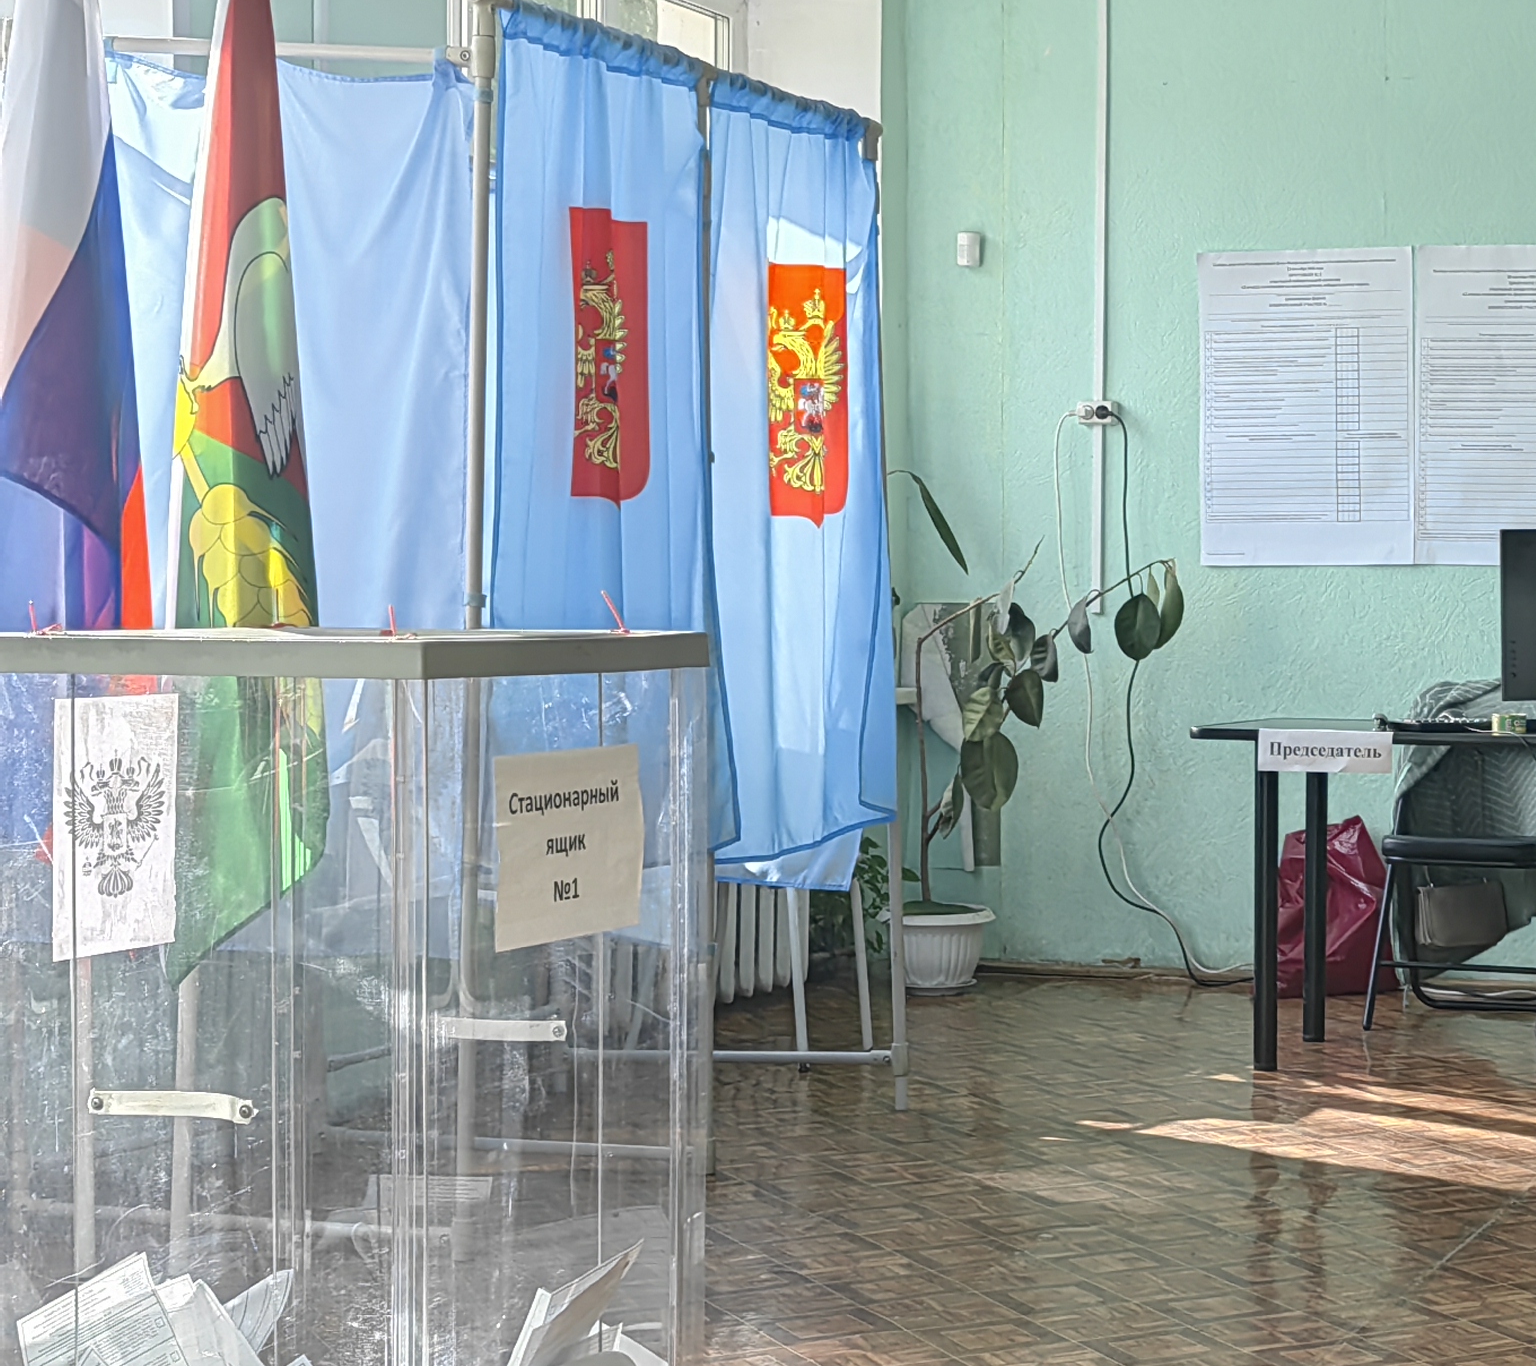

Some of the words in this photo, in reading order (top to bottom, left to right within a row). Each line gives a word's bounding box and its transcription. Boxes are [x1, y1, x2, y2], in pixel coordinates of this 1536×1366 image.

[1269, 741, 1382, 760] Председатель
[508, 779, 619, 816] Стационарный
[545, 833, 586, 857] ящик
[553, 877, 580, 903] №1
